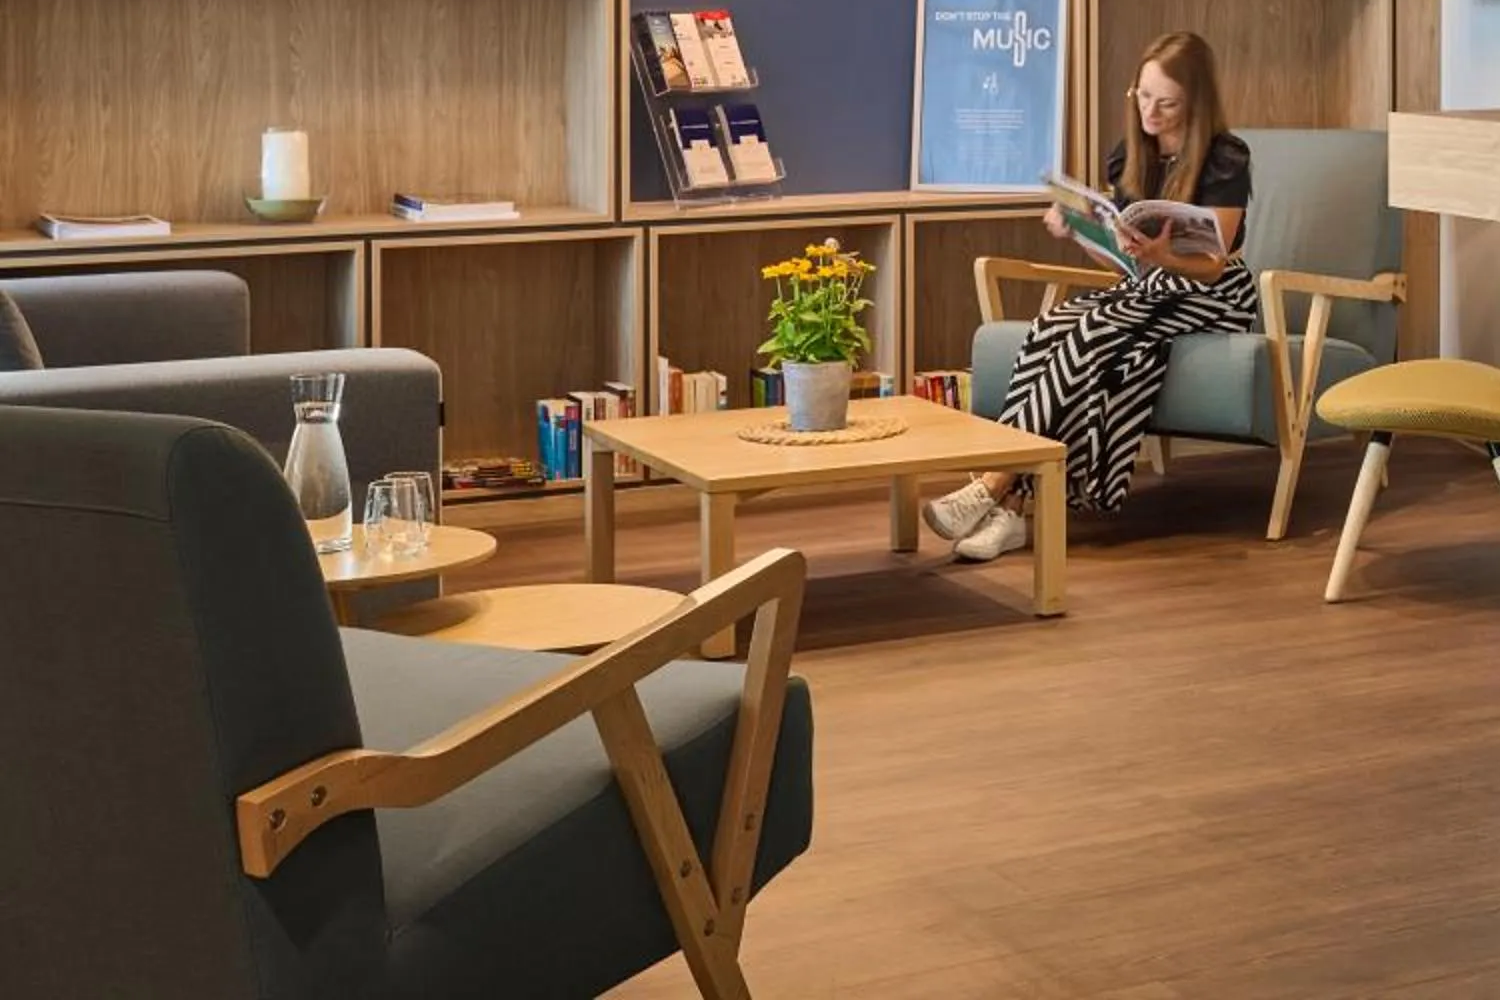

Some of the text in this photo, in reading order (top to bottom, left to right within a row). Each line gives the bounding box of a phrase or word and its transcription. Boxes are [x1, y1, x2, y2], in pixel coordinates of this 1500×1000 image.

[966, 11, 991, 21] STOP
[992, 11, 1012, 21] THE
[972, 10, 1051, 67] MUSIC
